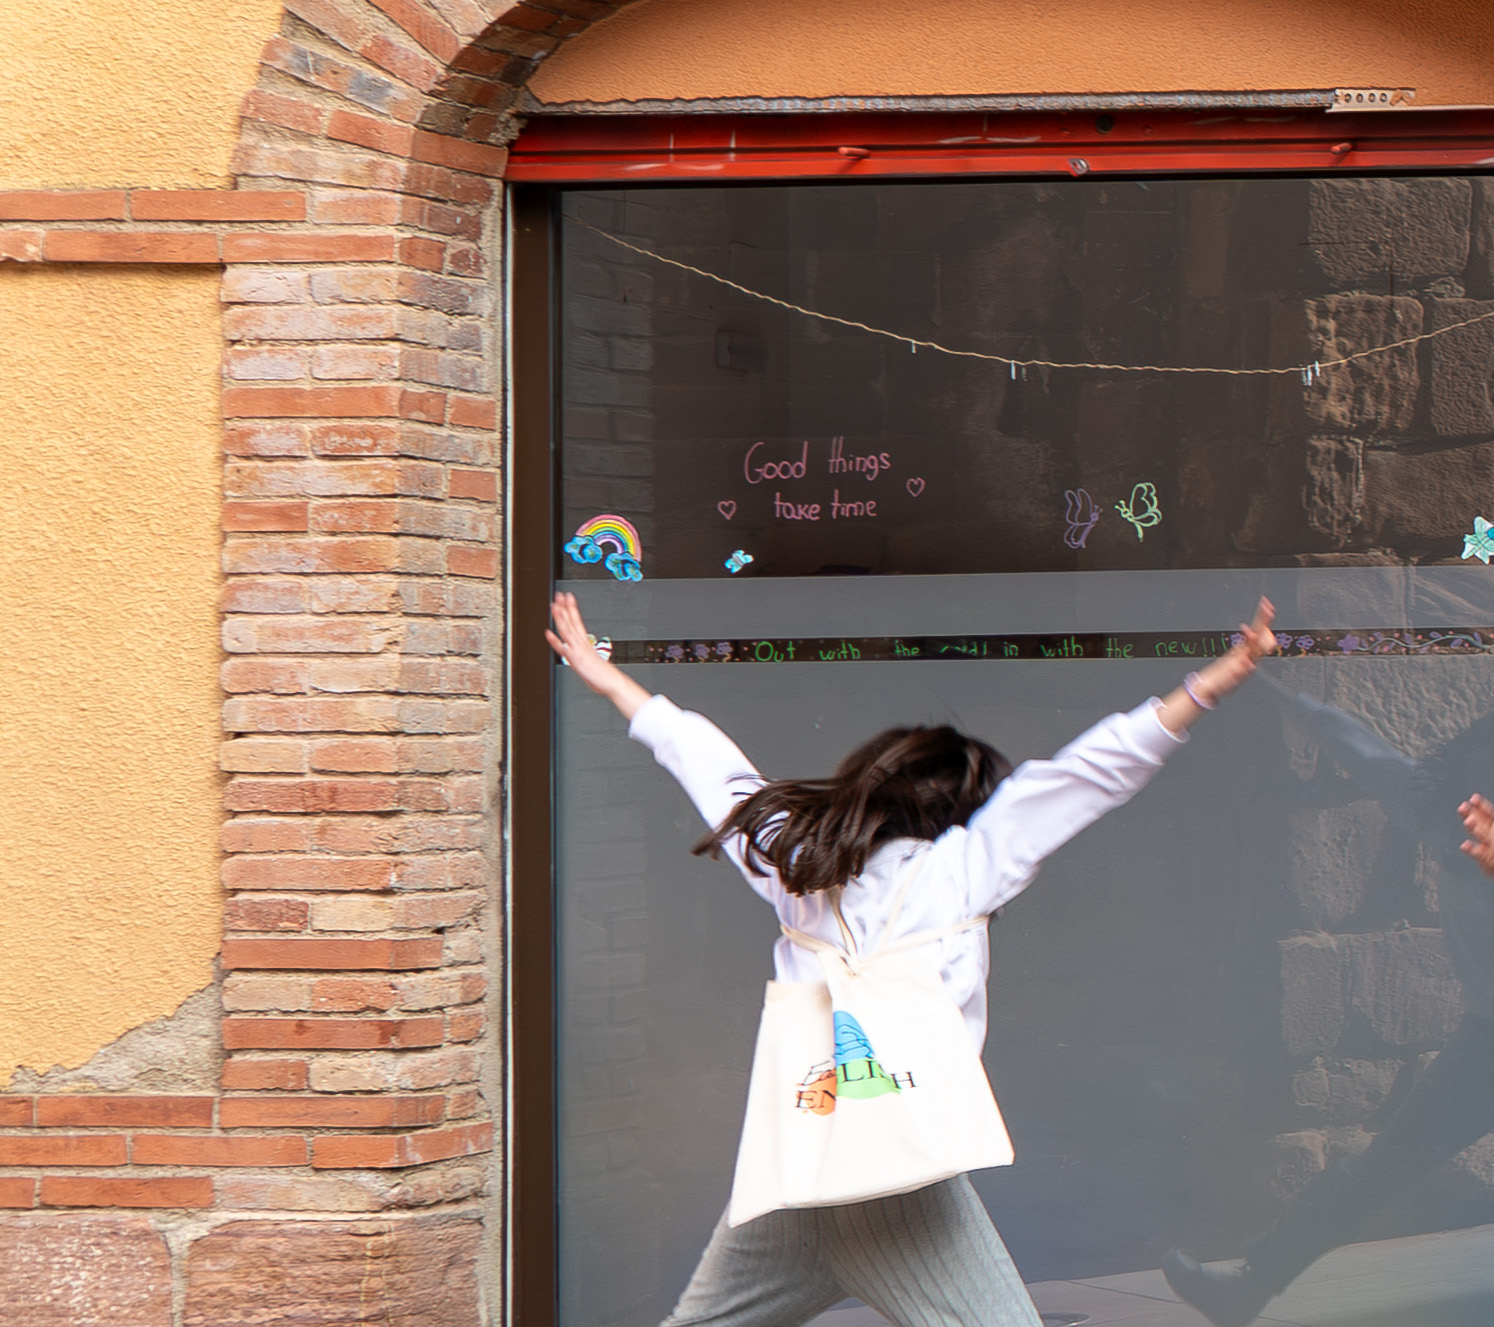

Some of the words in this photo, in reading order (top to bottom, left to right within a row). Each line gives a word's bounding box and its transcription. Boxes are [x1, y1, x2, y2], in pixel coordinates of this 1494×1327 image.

[744, 440, 808, 484] Good
[828, 436, 891, 481] things
[774, 492, 820, 521] take
[830, 489, 877, 520] time
[755, 640, 796, 662] Out
[819, 640, 862, 660] with
[1003, 641, 1019, 657] in
[1040, 636, 1084, 658] with
[1105, 637, 1134, 659] the
